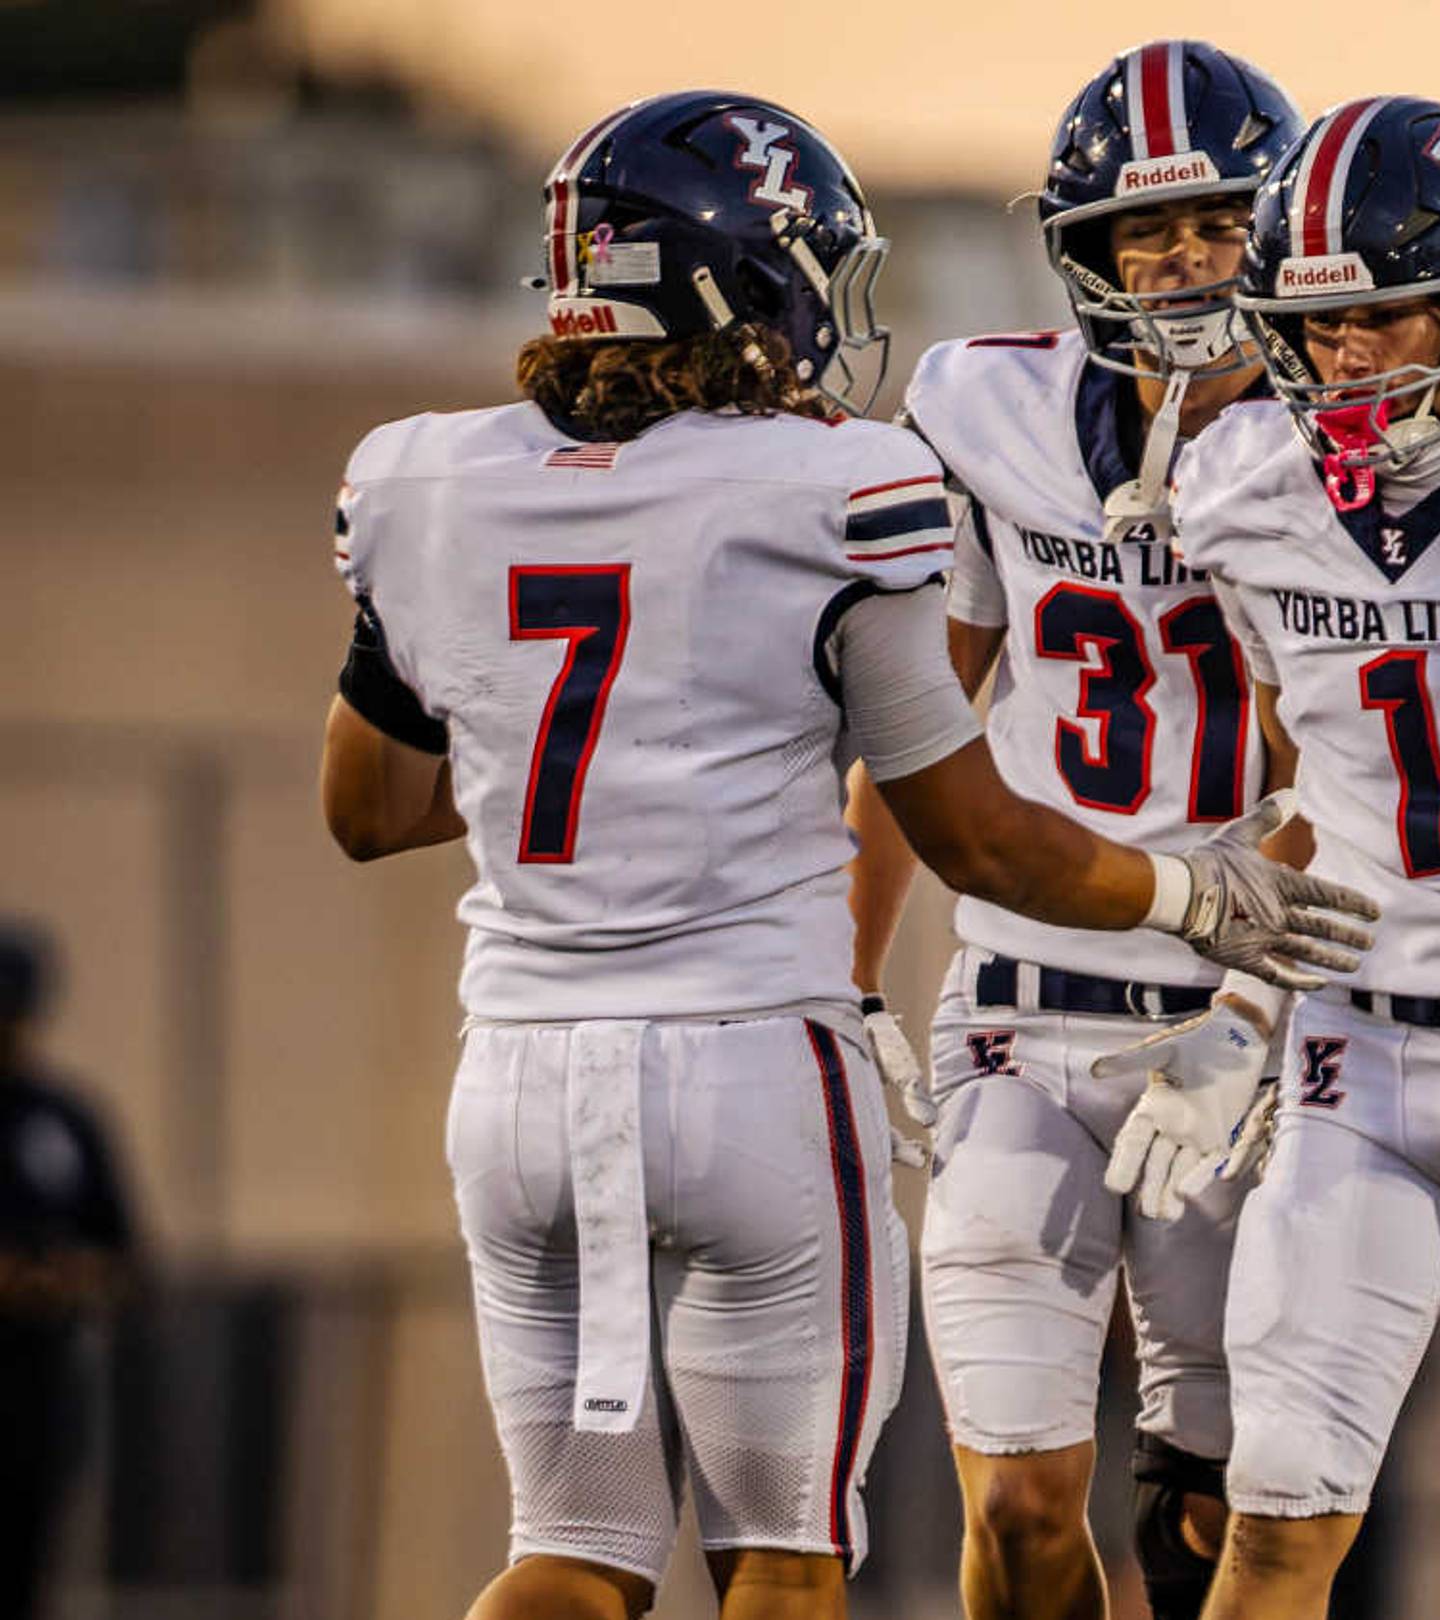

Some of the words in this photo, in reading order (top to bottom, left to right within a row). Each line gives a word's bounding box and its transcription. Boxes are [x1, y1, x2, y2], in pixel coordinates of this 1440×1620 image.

[1125, 161, 1206, 190] Riddell
[1283, 263, 1358, 286] Riddell
[1014, 522, 1124, 584] YORBA
[1275, 591, 1387, 641] YORBA
[508, 563, 632, 864] 7
[1033, 580, 1250, 824] 31
